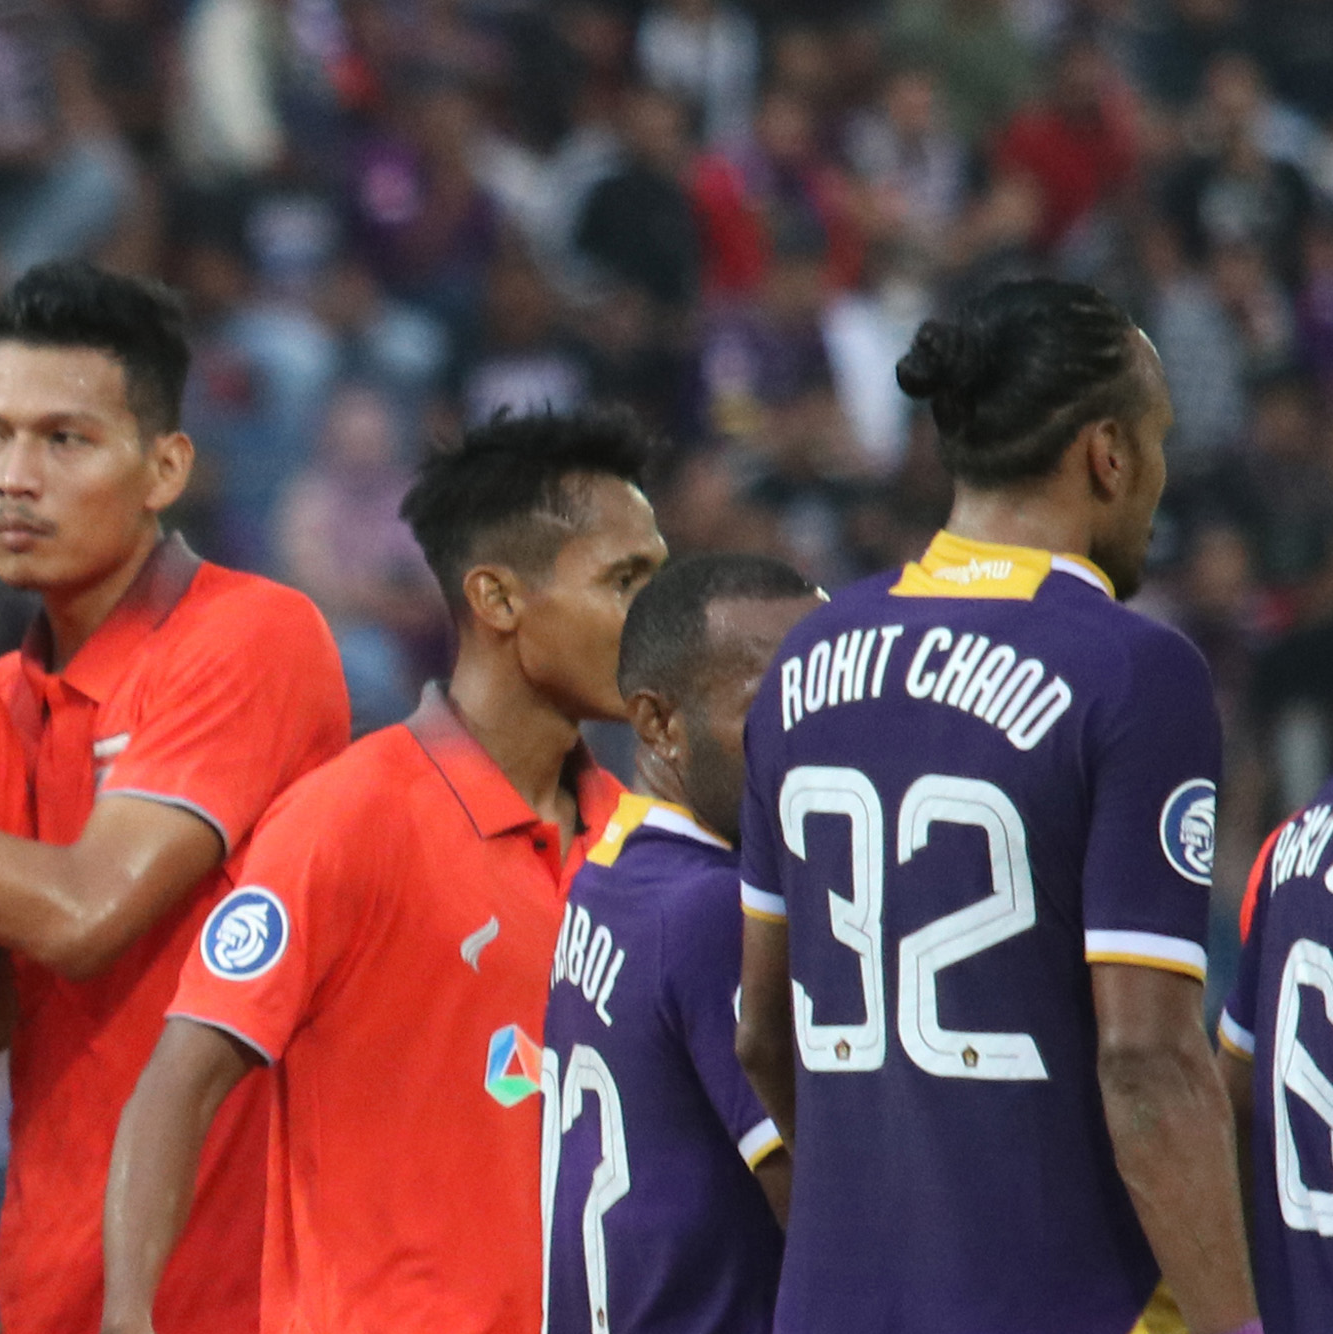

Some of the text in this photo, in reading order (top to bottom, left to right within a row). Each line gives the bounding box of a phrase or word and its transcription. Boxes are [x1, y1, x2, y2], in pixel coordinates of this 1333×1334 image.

[781, 624, 1073, 751] ROHIT CHAND
[779, 765, 1049, 1081] 32
